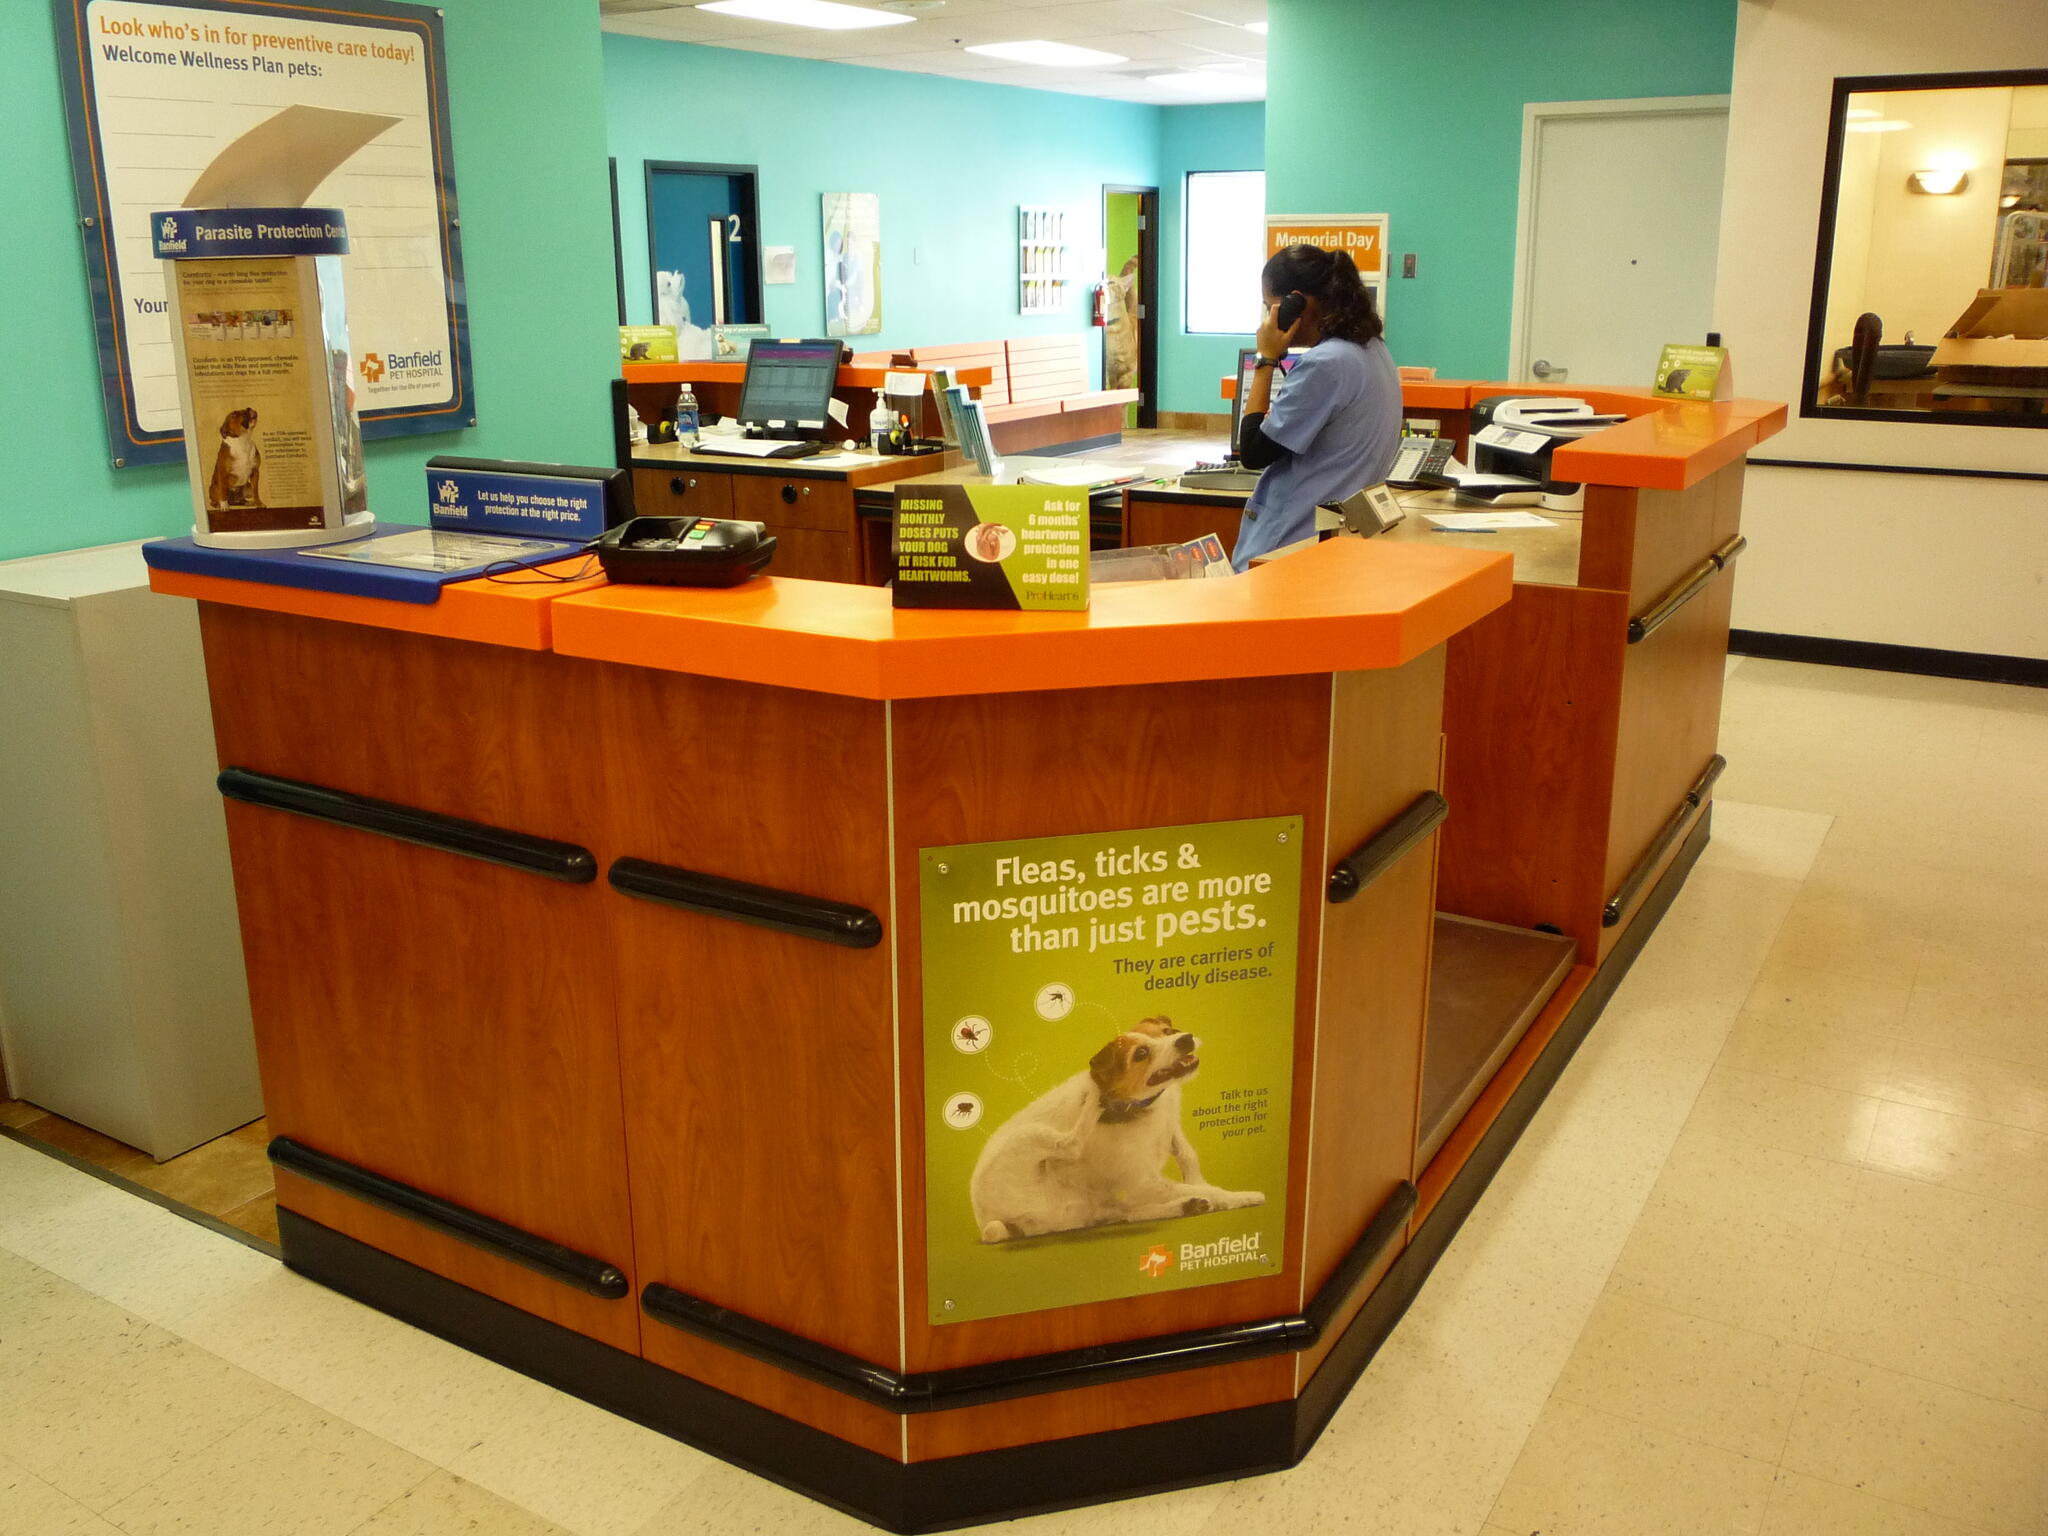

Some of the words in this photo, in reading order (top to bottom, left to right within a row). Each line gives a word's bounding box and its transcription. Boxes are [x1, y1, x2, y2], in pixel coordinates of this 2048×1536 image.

[100, 15, 145, 37] Look
[204, 24, 220, 44] in
[224, 26, 248, 45] for
[252, 32, 333, 52] preventive
[337, 41, 368, 57] care
[371, 43, 415, 65] today!
[102, 44, 177, 65] Welcome
[180, 50, 249, 71] Wellness
[252, 56, 284, 74] Plan
[288, 61, 322, 78] pets:
[195, 224, 253, 241] Parasite
[257, 224, 323, 239] Protection
[728, 214, 741, 241] 2
[159, 239, 187, 251] Banfield
[1275, 231, 1343, 248] Memorial
[1346, 232, 1375, 251] Day
[133, 298, 168, 314] Your
[388, 350, 442, 369] Banfield
[390, 370, 404, 380] PET
[406, 368, 443, 378] HOSPITAL
[477, 490, 489, 501] Let
[490, 493, 499, 502] us
[499, 492, 515, 505] help
[516, 495, 529, 506] you
[530, 495, 555, 506] choose
[556, 496, 569, 507] the
[570, 497, 588, 510] right
[900, 499, 943, 511] MISSING
[1044, 500, 1063, 512] Ask
[1065, 500, 1081, 512] for
[432, 503, 468, 516] Banfield
[484, 504, 520, 516] protection
[520, 507, 529, 517] at
[529, 507, 540, 518] the
[542, 508, 559, 521] right
[560, 510, 581, 522] price.
[900, 513, 945, 525] MONTHLY
[1028, 513, 1036, 526] 6
[900, 527, 931, 539] DOSES
[933, 527, 959, 539] PUTS
[1021, 528, 1080, 540] heartworm
[899, 541, 925, 553] YOUR
[927, 541, 948, 553] DOG
[1024, 543, 1080, 555] protection
[899, 555, 911, 567] AT
[912, 555, 936, 567] RISK
[938, 556, 957, 568] FOR
[1058, 558, 1080, 569] one
[899, 570, 972, 582] HEARTWORMS.
[1022, 572, 1048, 584] easy
[1049, 572, 1080, 584] dose!
[996, 855, 1085, 887] Fleas,
[1096, 847, 1168, 878] ticks
[1177, 843, 1201, 870] &
[953, 886, 1133, 923] mosquitoes
[1142, 879, 1189, 906] are
[1198, 872, 1272, 900] more
[1010, 924, 1079, 953] than
[1088, 915, 1146, 952] just
[1156, 900, 1267, 948] pests.
[1113, 957, 1154, 975] They
[1159, 954, 1185, 970] are
[1190, 947, 1253, 967] carriers
[1258, 942, 1275, 958] of
[1144, 971, 1200, 992] deadly
[1205, 964, 1272, 985] disease.
[1220, 1090, 1241, 1101] Talk
[1243, 1089, 1254, 1098] to
[1256, 1087, 1268, 1096] us
[1192, 1106, 1221, 1118] about
[1224, 1103, 1241, 1113] the
[1243, 1099, 1267, 1112] right
[1199, 1114, 1251, 1131] protection
[1253, 1112, 1268, 1122] for
[1222, 1127, 1244, 1140] your
[1247, 1124, 1267, 1137] pet.
[1180, 1232, 1260, 1261] Banfield
[1180, 1260, 1200, 1272] PET
[1203, 1253, 1260, 1268] HOSPITAL
